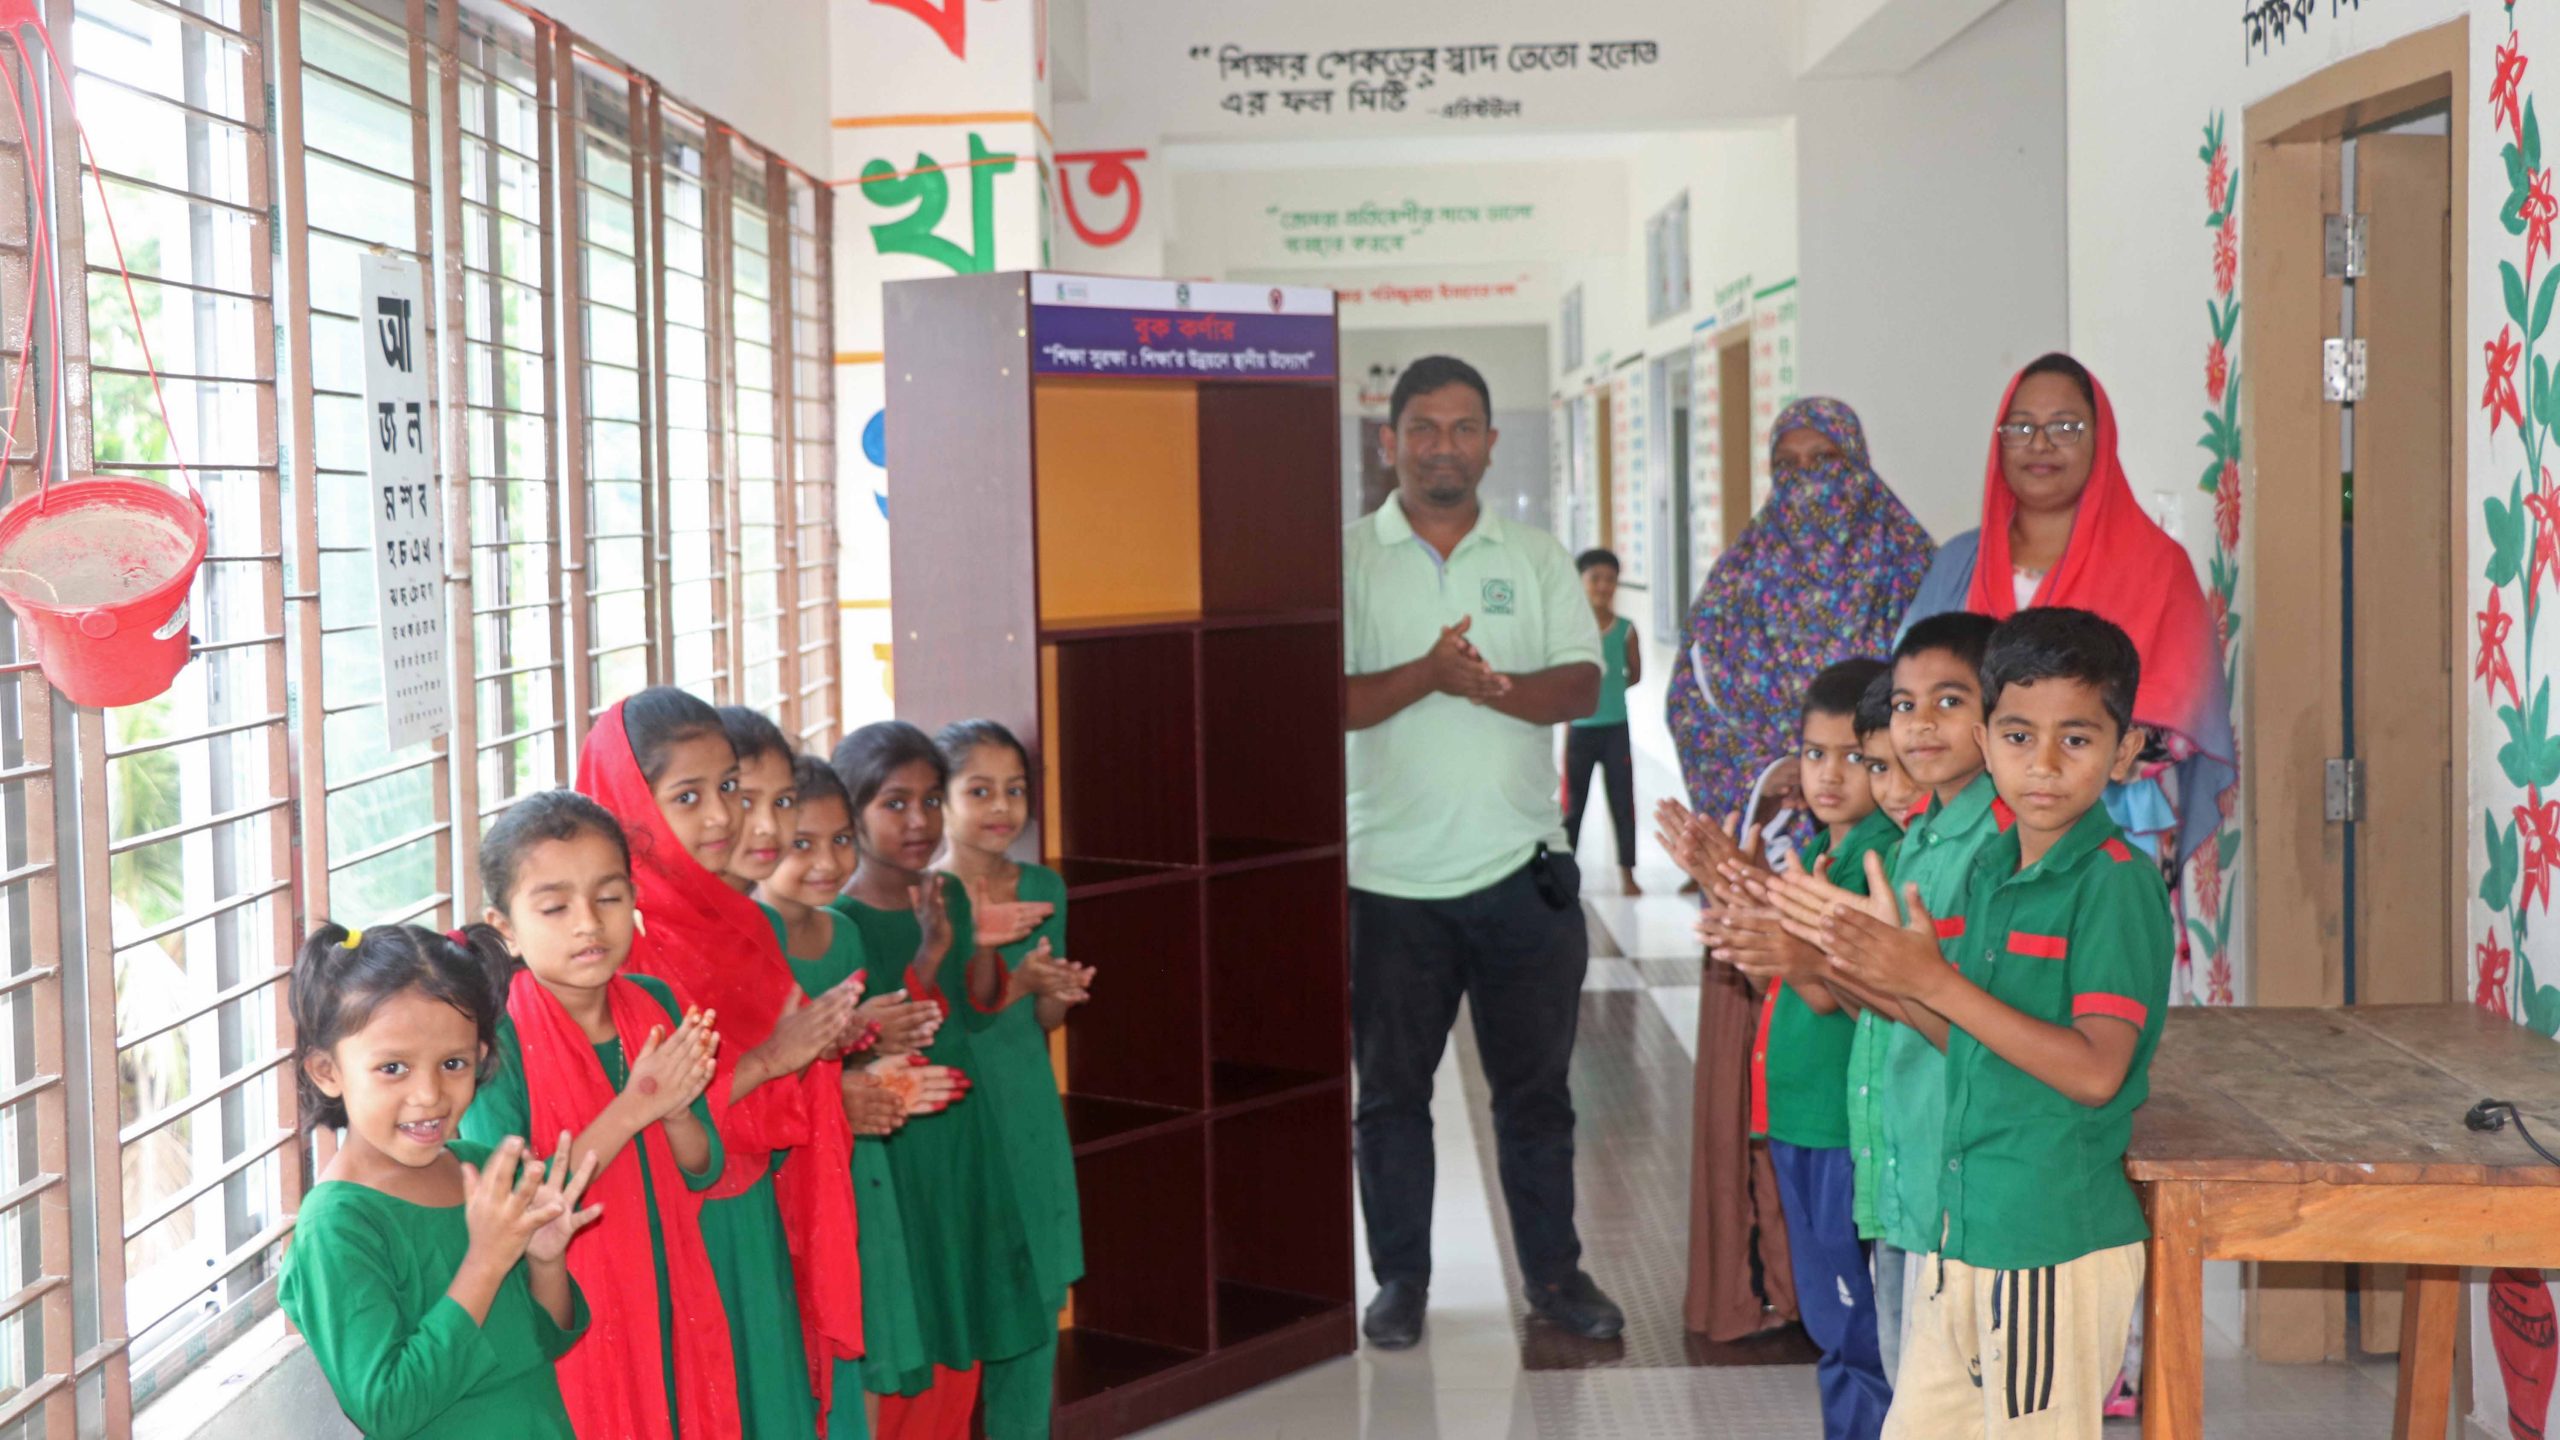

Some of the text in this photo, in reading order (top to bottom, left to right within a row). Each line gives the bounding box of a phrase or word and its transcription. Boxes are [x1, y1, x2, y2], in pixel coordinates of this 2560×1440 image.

[1444, 44, 1499, 74] স্বাদ
[1507, 43, 1579, 72] তেতো
[1588, 40, 1659, 70] হলেও
[1219, 92, 1268, 118] এর
[1279, 91, 1335, 115] ফল
[378, 297, 412, 373] আ
[1132, 316, 1170, 345] বুক
